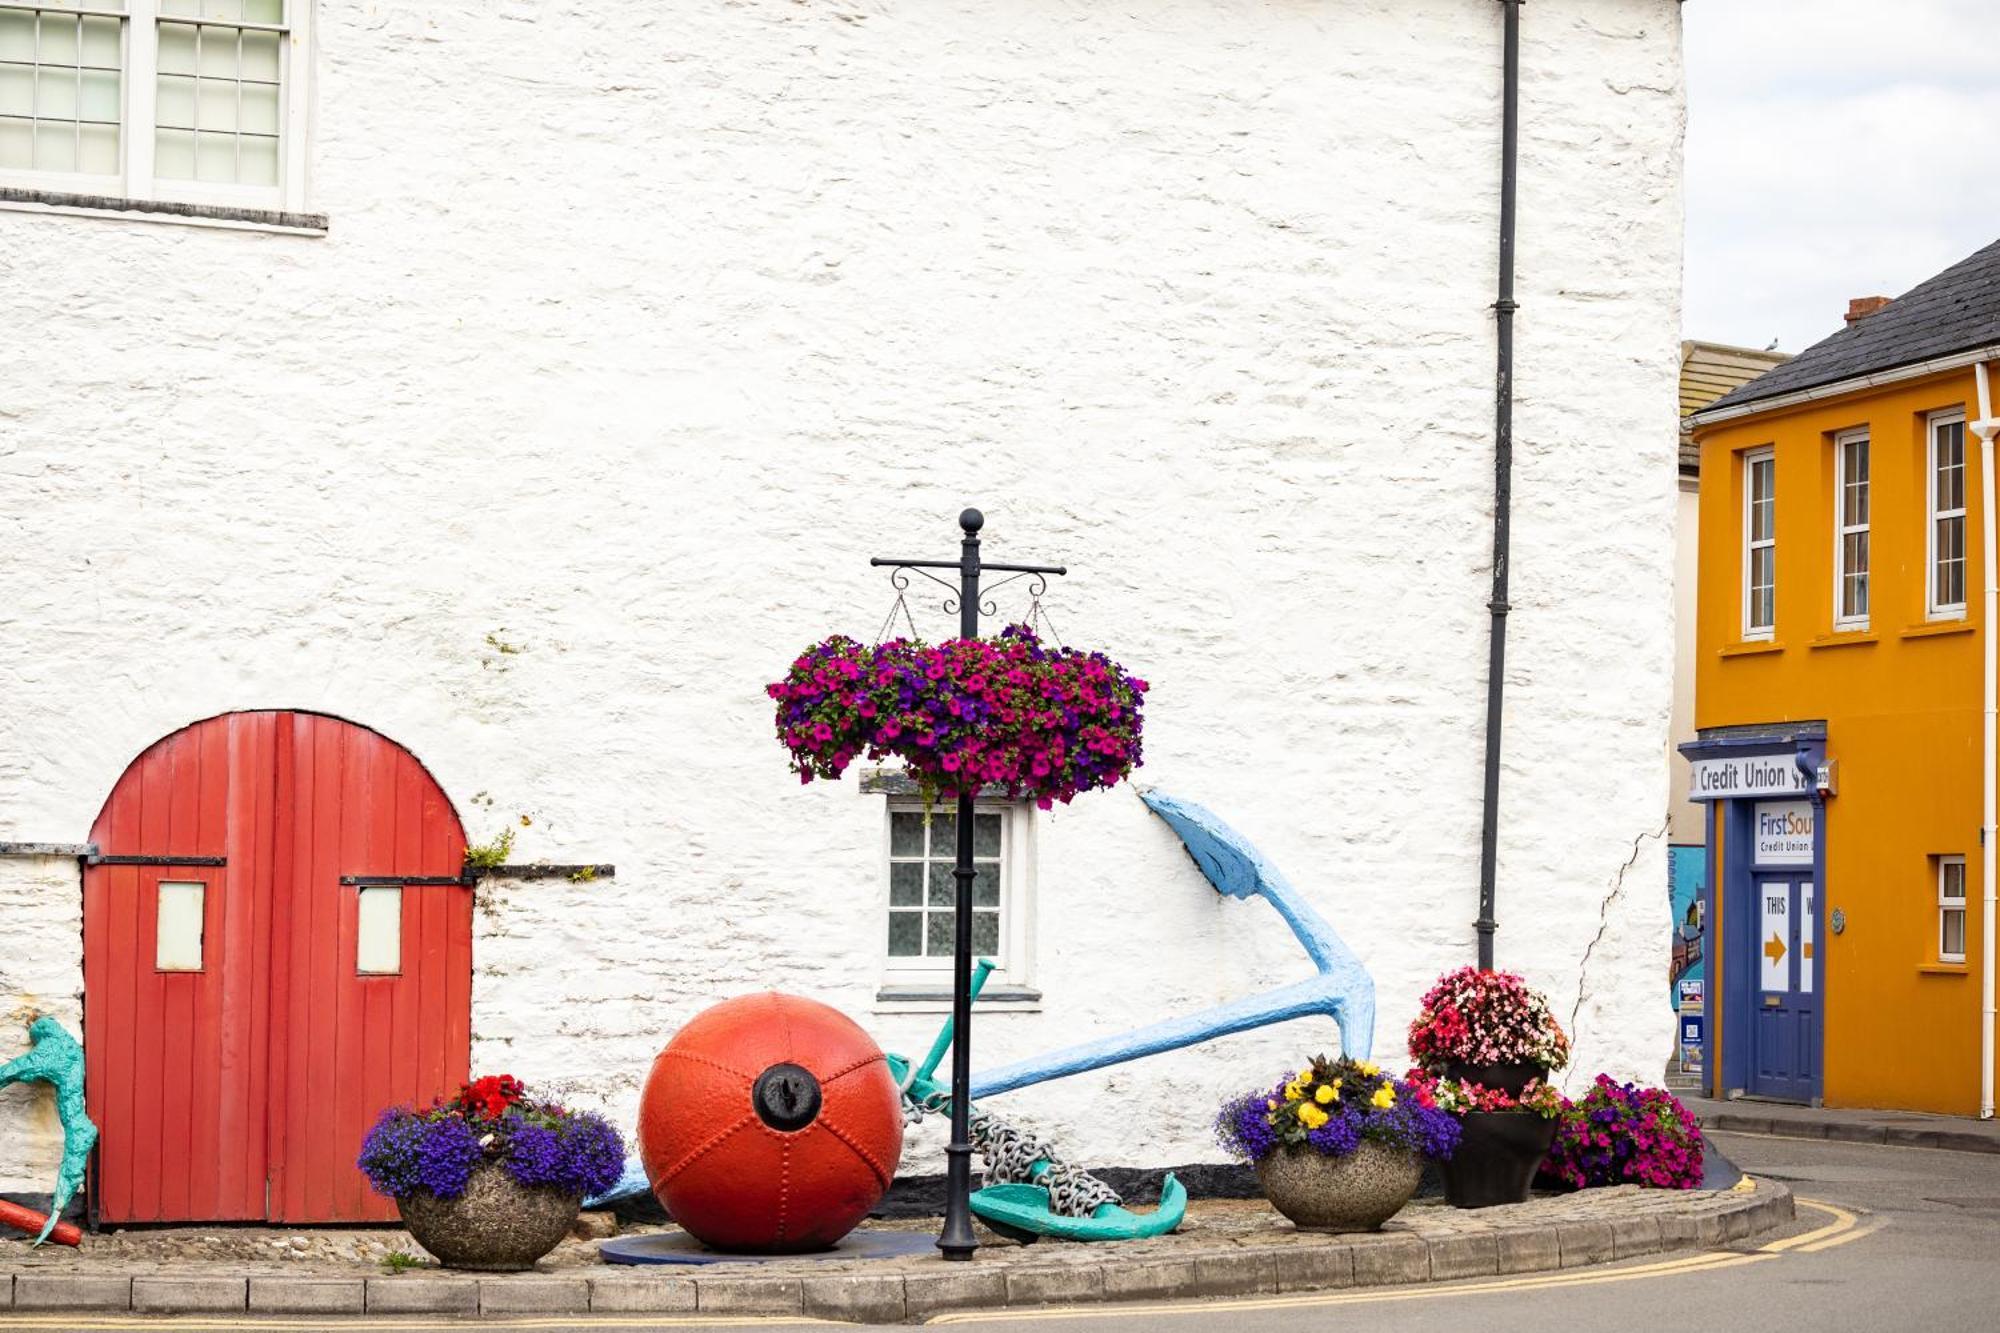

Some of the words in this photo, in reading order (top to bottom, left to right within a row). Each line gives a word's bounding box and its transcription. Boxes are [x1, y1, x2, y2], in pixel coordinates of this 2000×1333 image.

[1701, 763, 1738, 791] Credit
[1745, 761, 1785, 788] Union
[1760, 811, 1813, 836] FirstSou
[1760, 841, 1784, 852] Credit
[1786, 841, 1809, 852] Union
[1766, 896, 1786, 915] THIS
